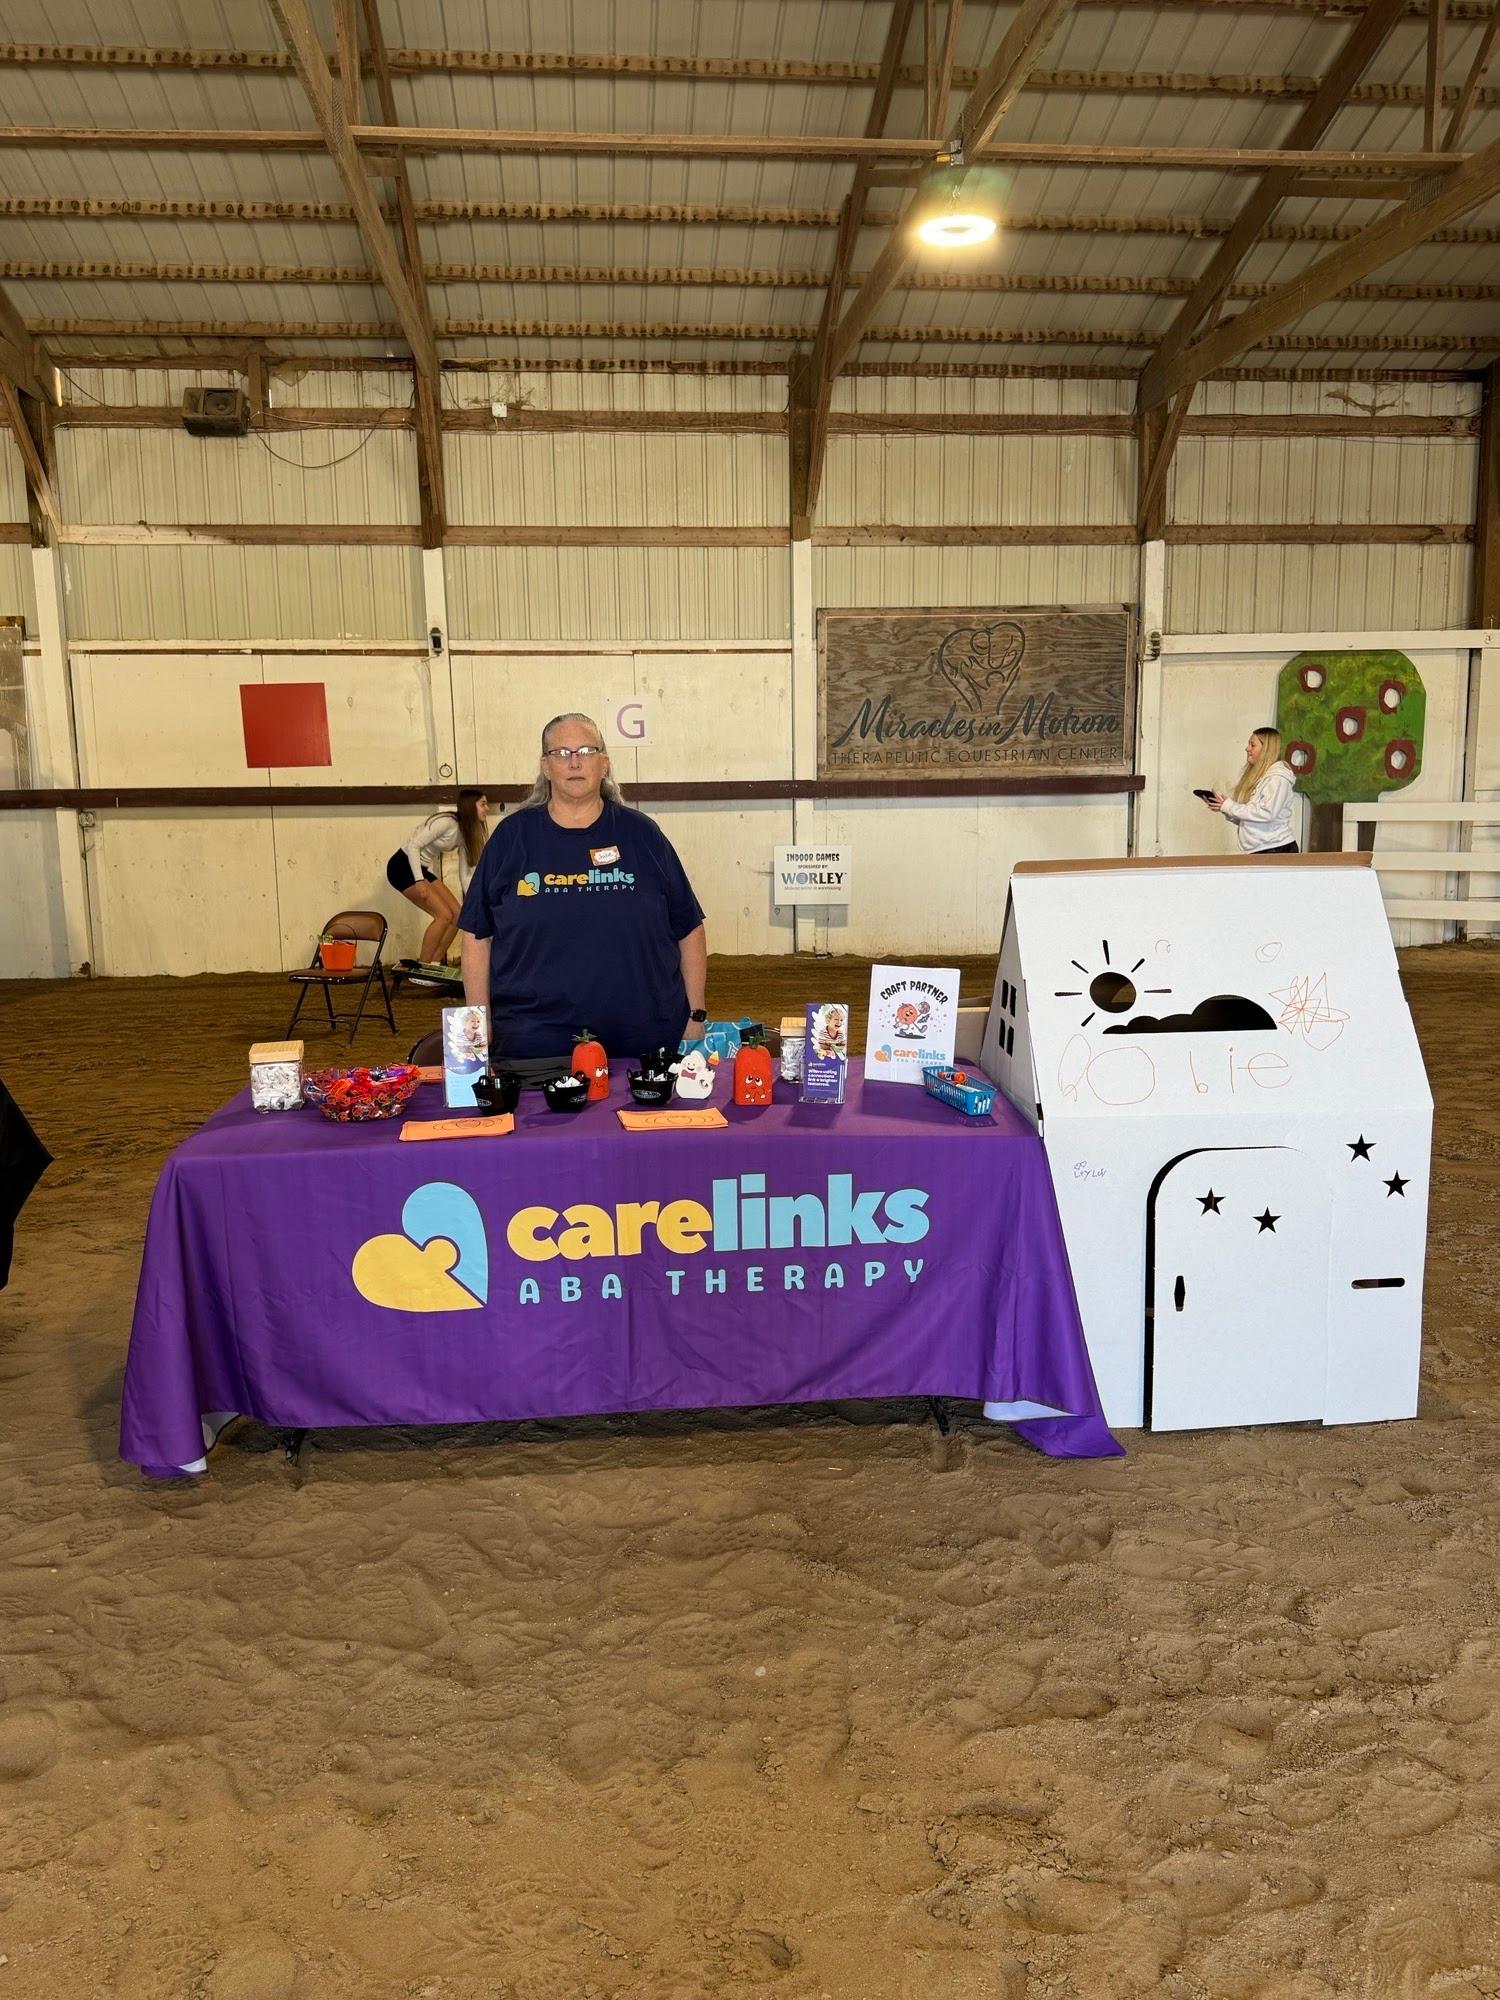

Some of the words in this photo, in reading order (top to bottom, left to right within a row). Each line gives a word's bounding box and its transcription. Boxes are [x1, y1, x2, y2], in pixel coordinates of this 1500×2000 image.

[616, 703, 645, 739] G
[832, 694, 974, 747] Miracles
[979, 718, 1003, 738] in
[994, 692, 1119, 745] Motion
[832, 750, 941, 764] THERAPEUTIC
[949, 748, 1050, 763] EQUESTRIAN
[1057, 747, 1118, 761] CENTER
[786, 853, 814, 862] INDOOR
[815, 853, 840, 862] GAMES
[544, 868, 635, 885] carelinks
[781, 872, 844, 884] WORLEY
[578, 884, 636, 893] THERAPY
[880, 980, 907, 1000] CRAFT
[910, 980, 949, 1005] PARTNER
[893, 1048, 946, 1061] carelinks
[507, 1172, 931, 1262] carelinks
[518, 1273, 624, 1305] ABA
[665, 1258, 925, 1297] THERAPY
